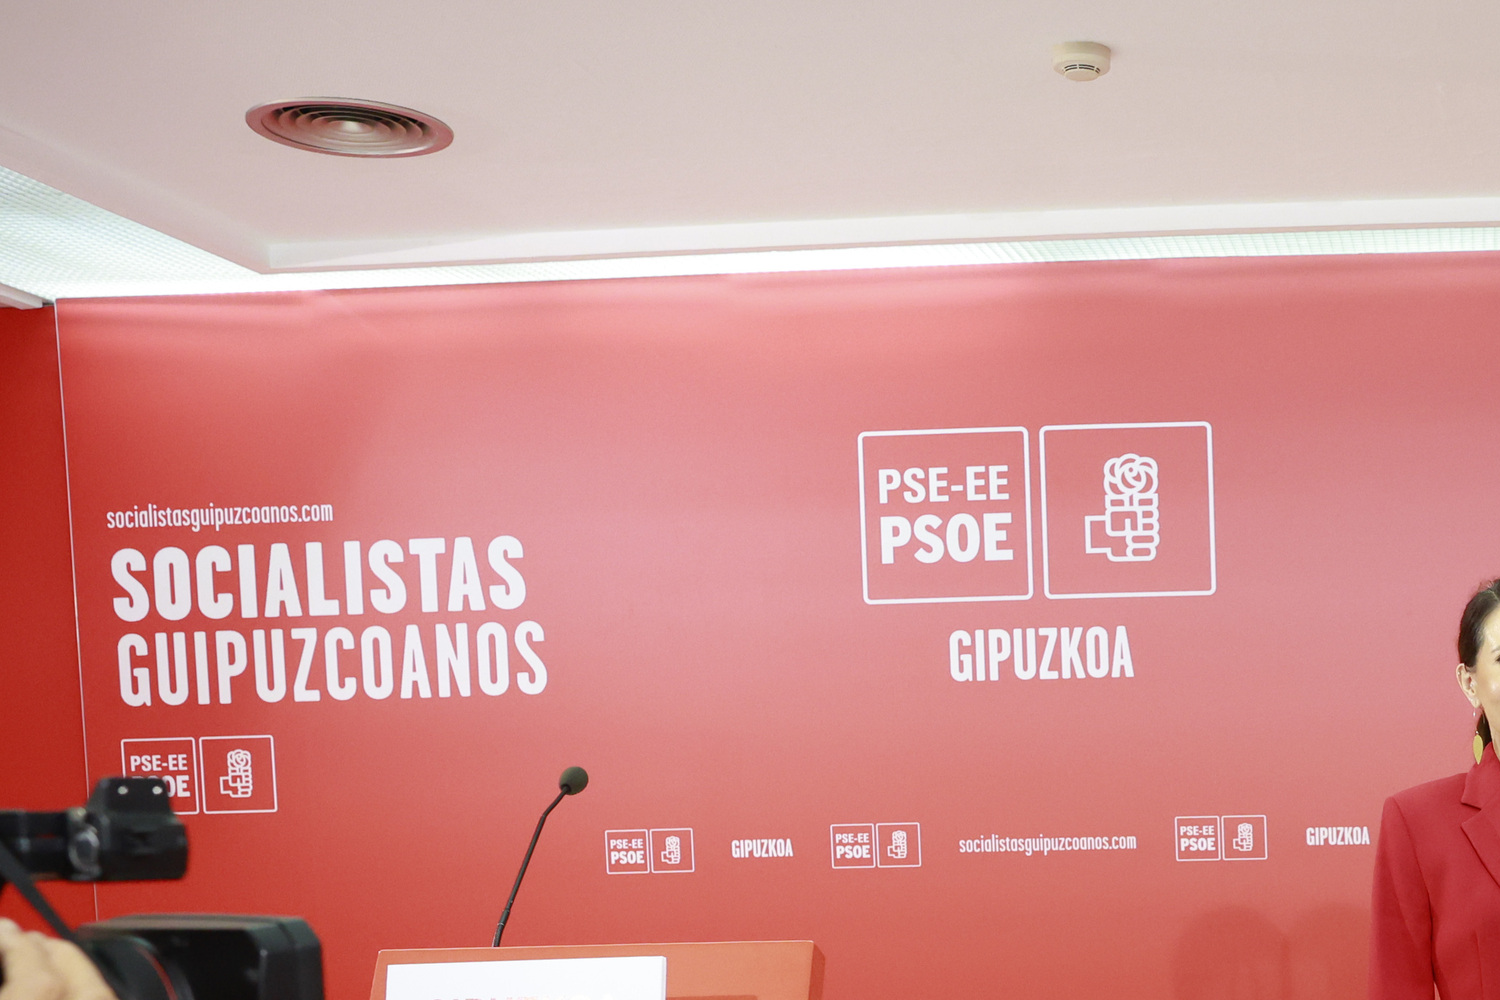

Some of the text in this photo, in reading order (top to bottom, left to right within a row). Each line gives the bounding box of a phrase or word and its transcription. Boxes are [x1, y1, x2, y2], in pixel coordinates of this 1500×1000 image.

[879, 465, 1009, 503] PSE-EE
[107, 503, 333, 532] socialistasguipuzcoanos.com
[880, 513, 1013, 564] PSOE
[111, 536, 526, 621] SOCIALISTAS
[950, 626, 1134, 681] GIPUZKOA
[118, 620, 548, 706] GUIPUZCOANOS
[131, 754, 187, 771] PSE-EE
[836, 833, 869, 843] PSE-EE
[1180, 826, 1214, 835] PSE-EE
[1306, 827, 1370, 845] GIPUZKOA
[610, 839, 643, 849] PSE-EE
[732, 839, 793, 858] GIPUZKOA
[836, 845, 870, 858] PSOE
[959, 834, 1136, 856] socialistasguipuzcoanos.com
[1181, 838, 1215, 851] PSOE
[611, 851, 644, 864] PSOE
